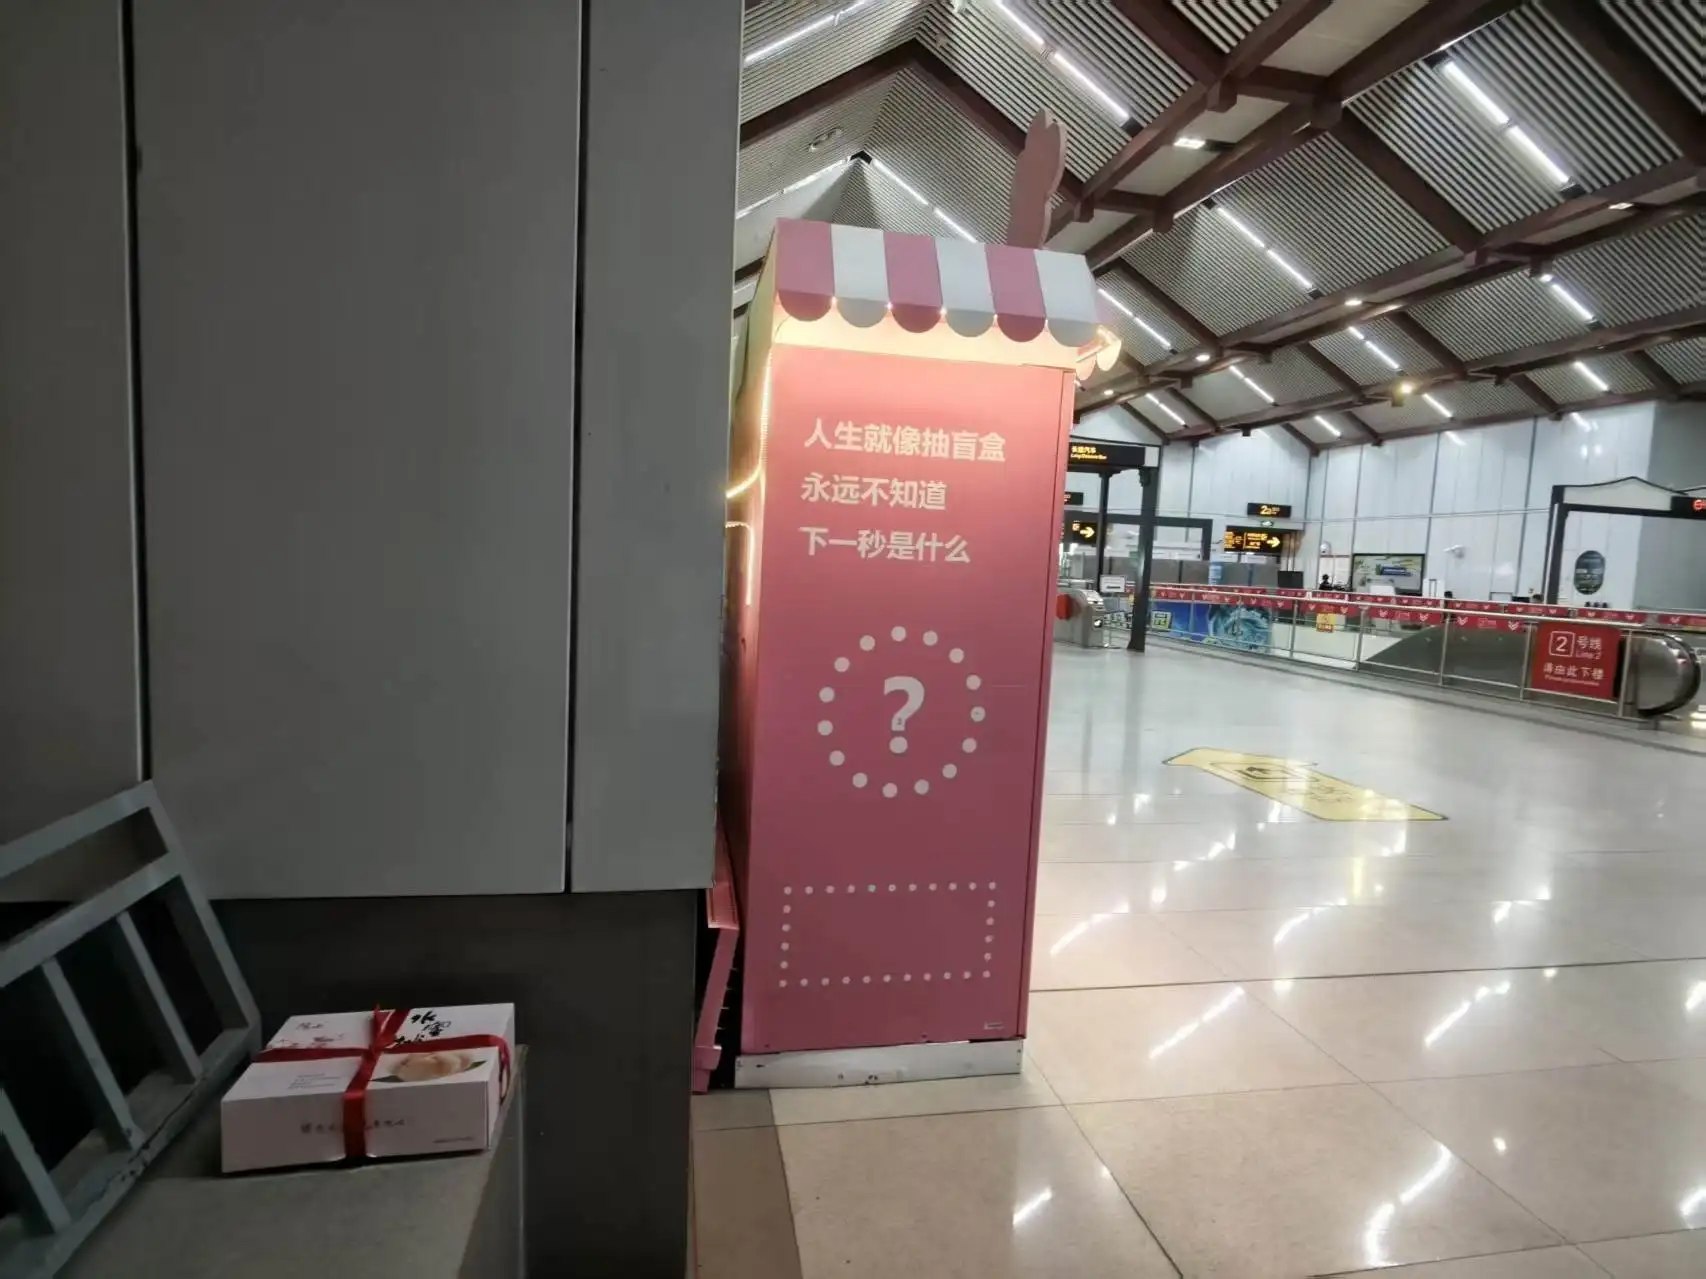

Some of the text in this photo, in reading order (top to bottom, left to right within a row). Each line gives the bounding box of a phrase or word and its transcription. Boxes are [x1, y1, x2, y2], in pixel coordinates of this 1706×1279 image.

[804, 417, 1006, 462] 人生就像抽盲盒
[801, 472, 947, 510] 永远不知道
[799, 526, 971, 563] 下一秒是什么
[883, 675, 925, 754] ?
